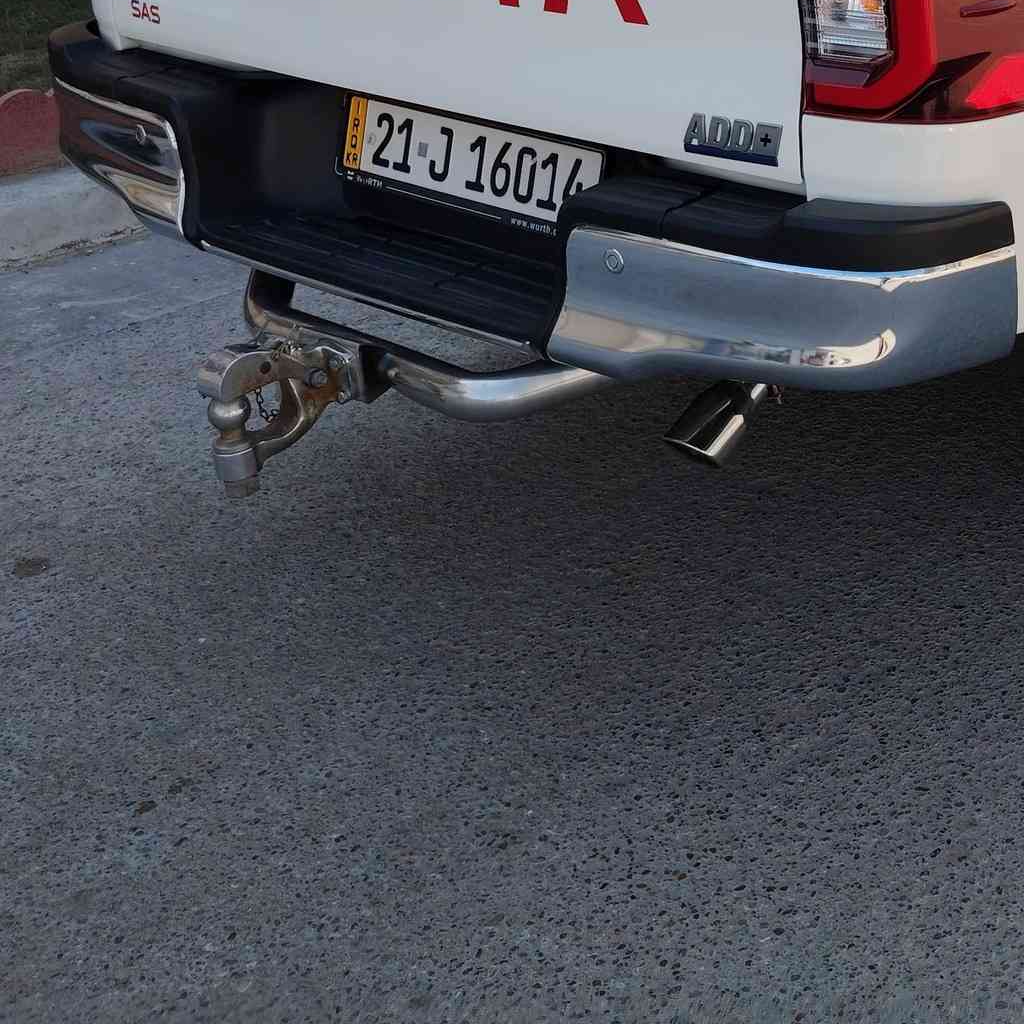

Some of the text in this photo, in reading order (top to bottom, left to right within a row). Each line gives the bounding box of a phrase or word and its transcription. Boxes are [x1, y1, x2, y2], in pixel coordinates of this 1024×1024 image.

[130, 0, 160, 25] SAS
[372, 112, 583, 213] 21 J 16014
